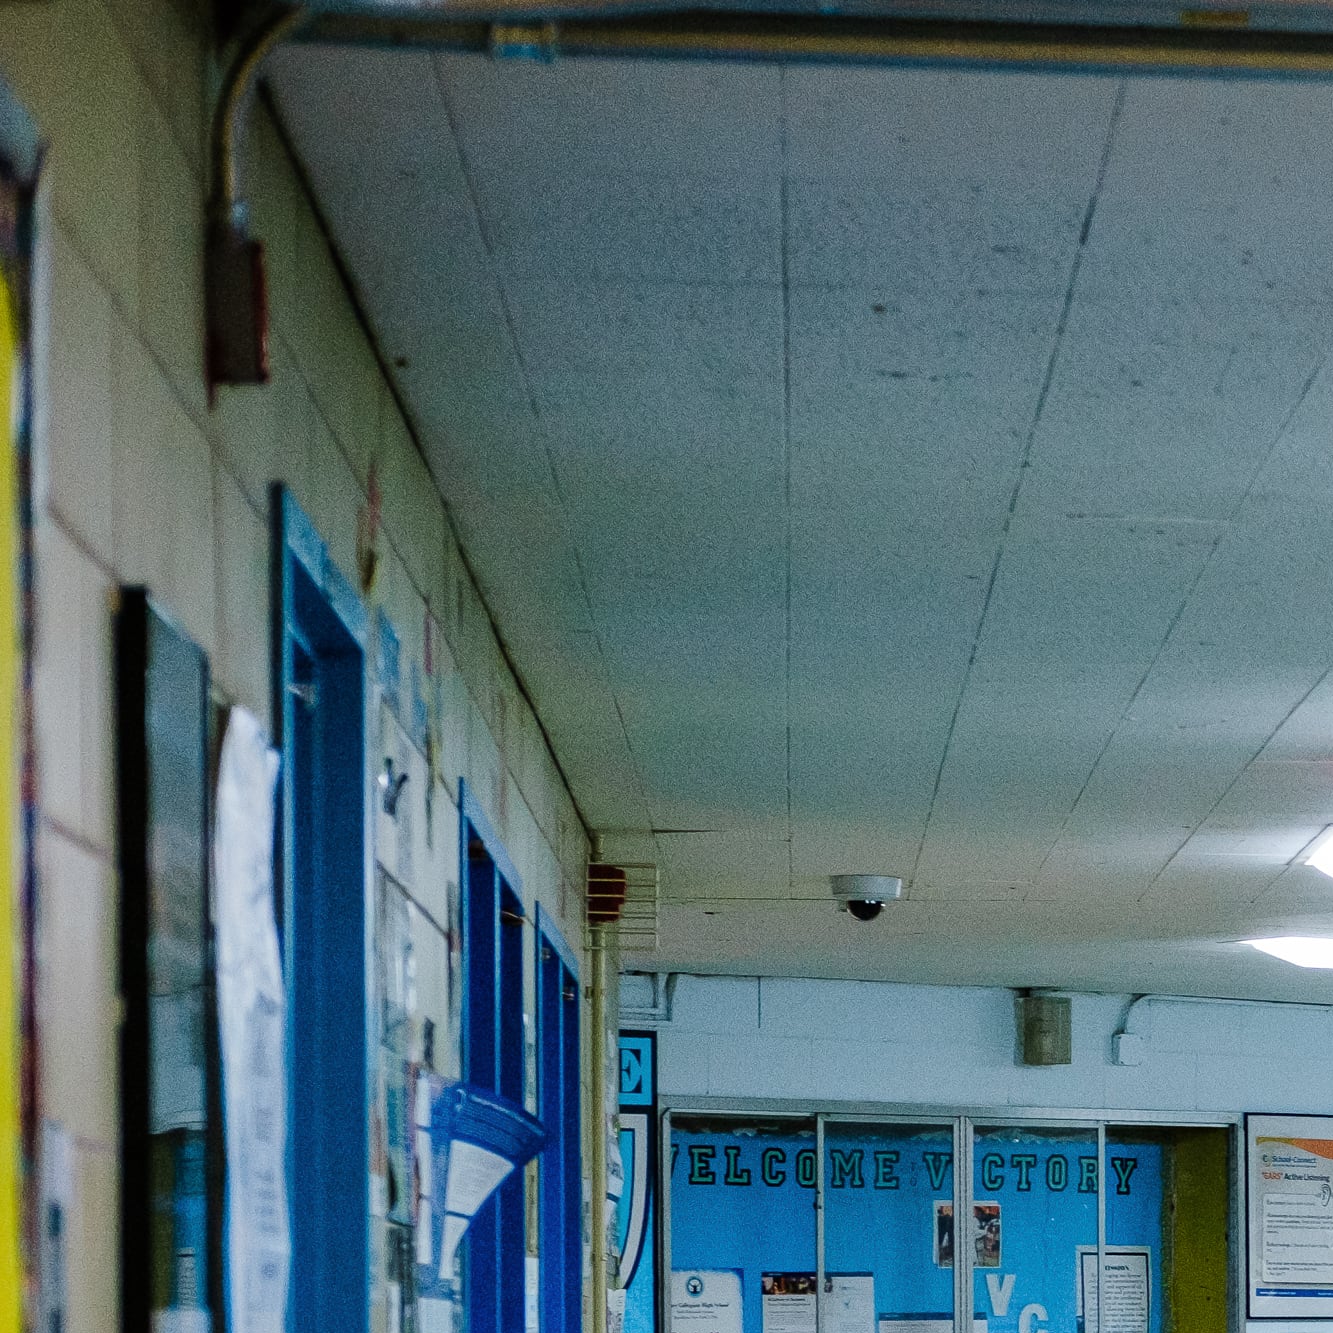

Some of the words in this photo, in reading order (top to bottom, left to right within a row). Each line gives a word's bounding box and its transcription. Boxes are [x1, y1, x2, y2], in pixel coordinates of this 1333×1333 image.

[671, 1144, 900, 1190] ELCOME
[923, 1151, 1137, 1195] VCTORY
[985, 1274, 1015, 1316] V
